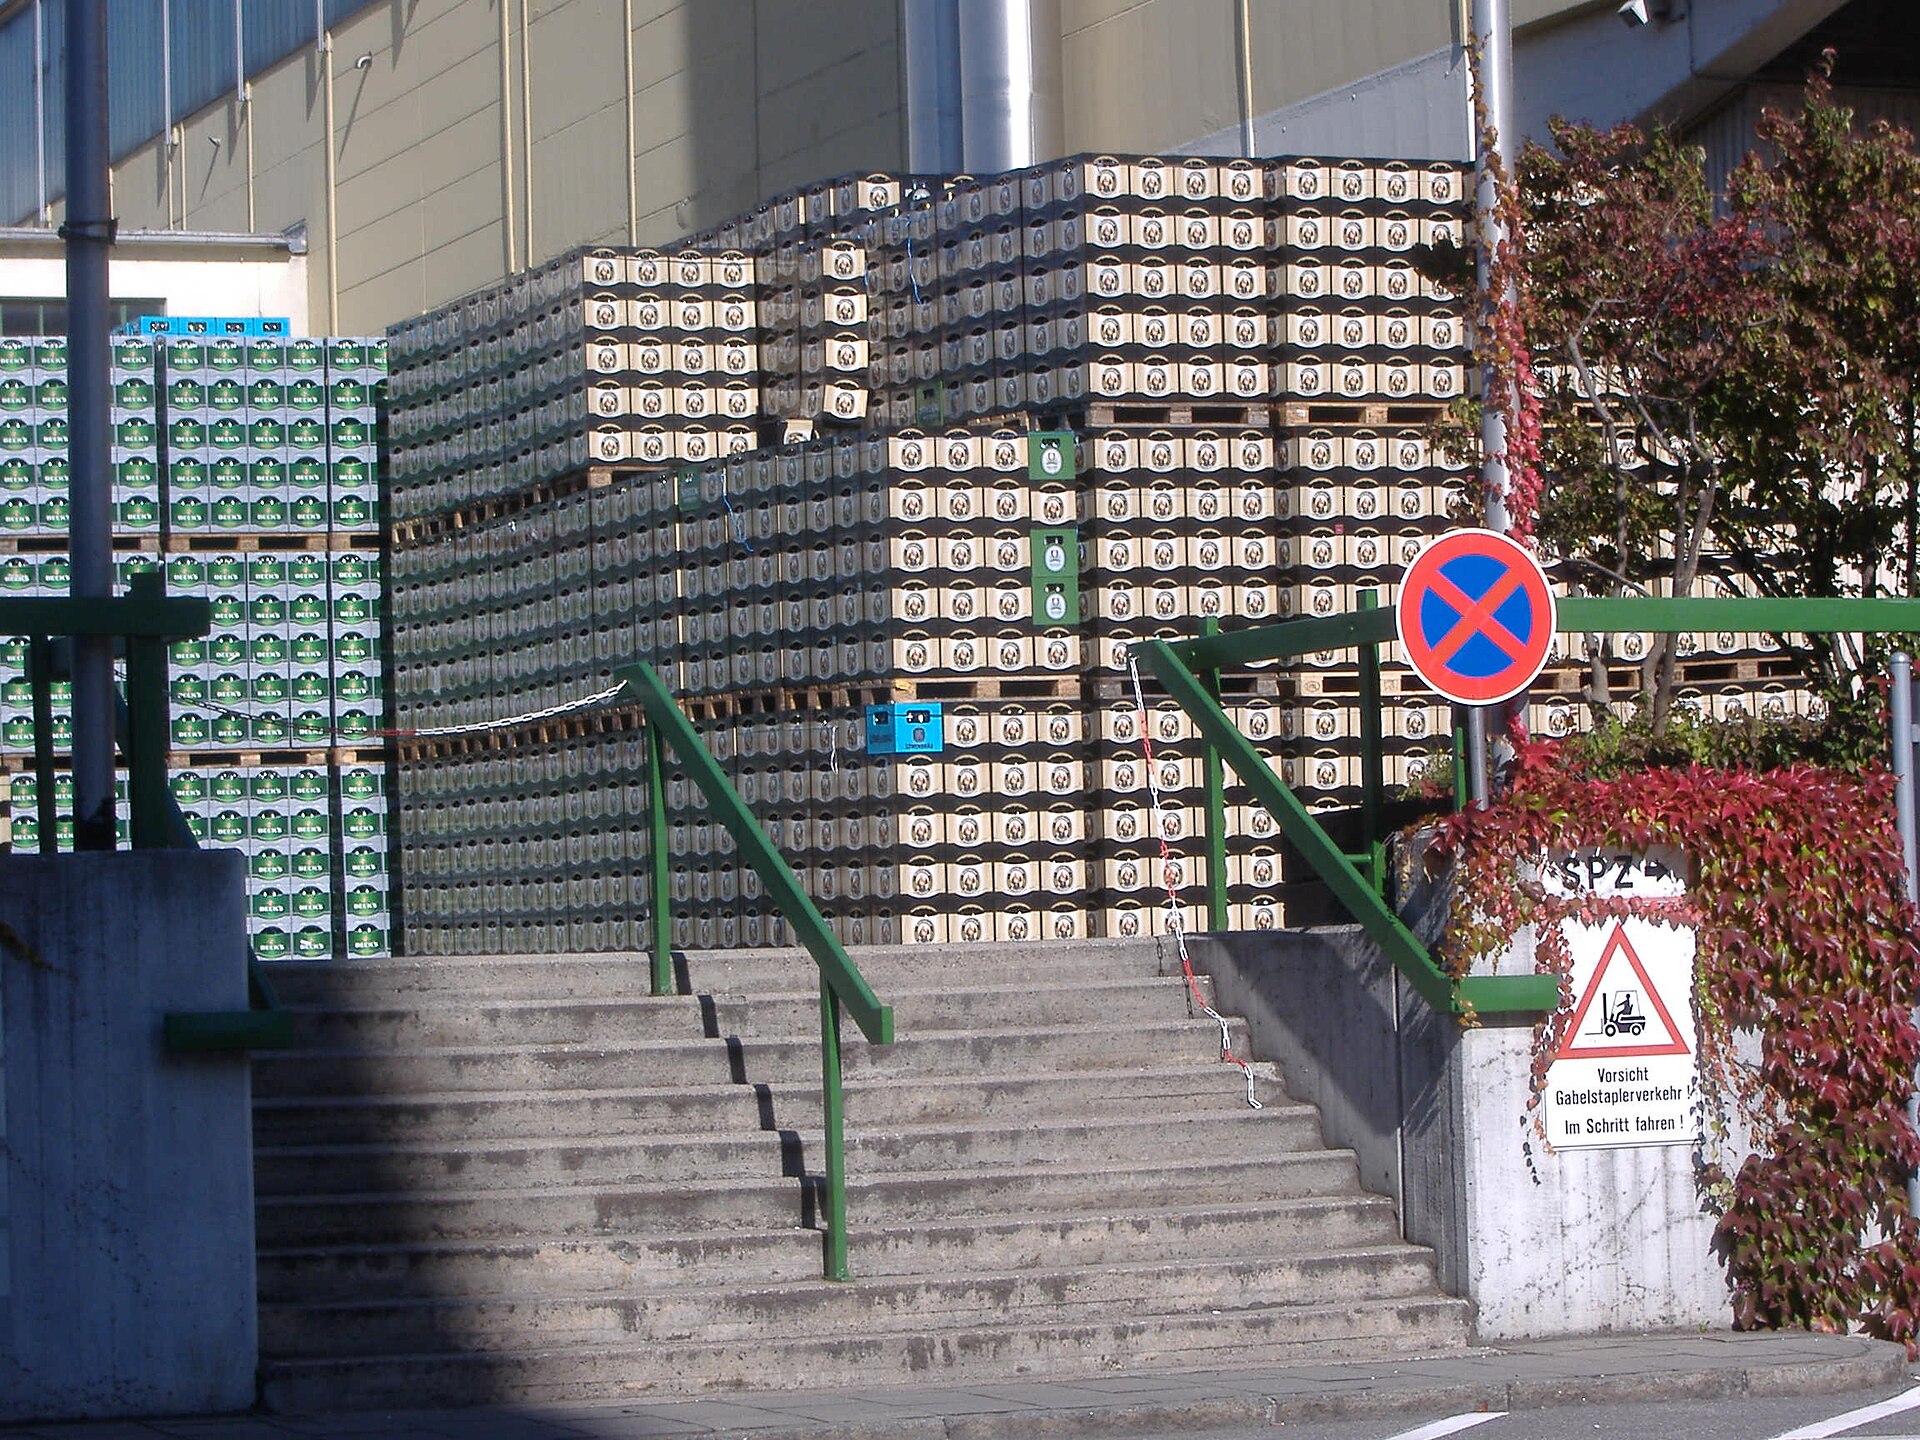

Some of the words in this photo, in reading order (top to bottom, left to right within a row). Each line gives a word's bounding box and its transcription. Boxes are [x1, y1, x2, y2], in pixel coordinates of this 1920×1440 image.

[1563, 855, 1633, 889] SPZ
[1597, 1067, 1649, 1083] Vorsicht
[1556, 1085, 1682, 1106] Gabelstaplerverkehr
[1565, 1119, 1580, 1135] Im
[1586, 1117, 1630, 1134] Schritt
[1635, 1115, 1675, 1132] fahren
[1680, 1114, 1684, 1130] !
